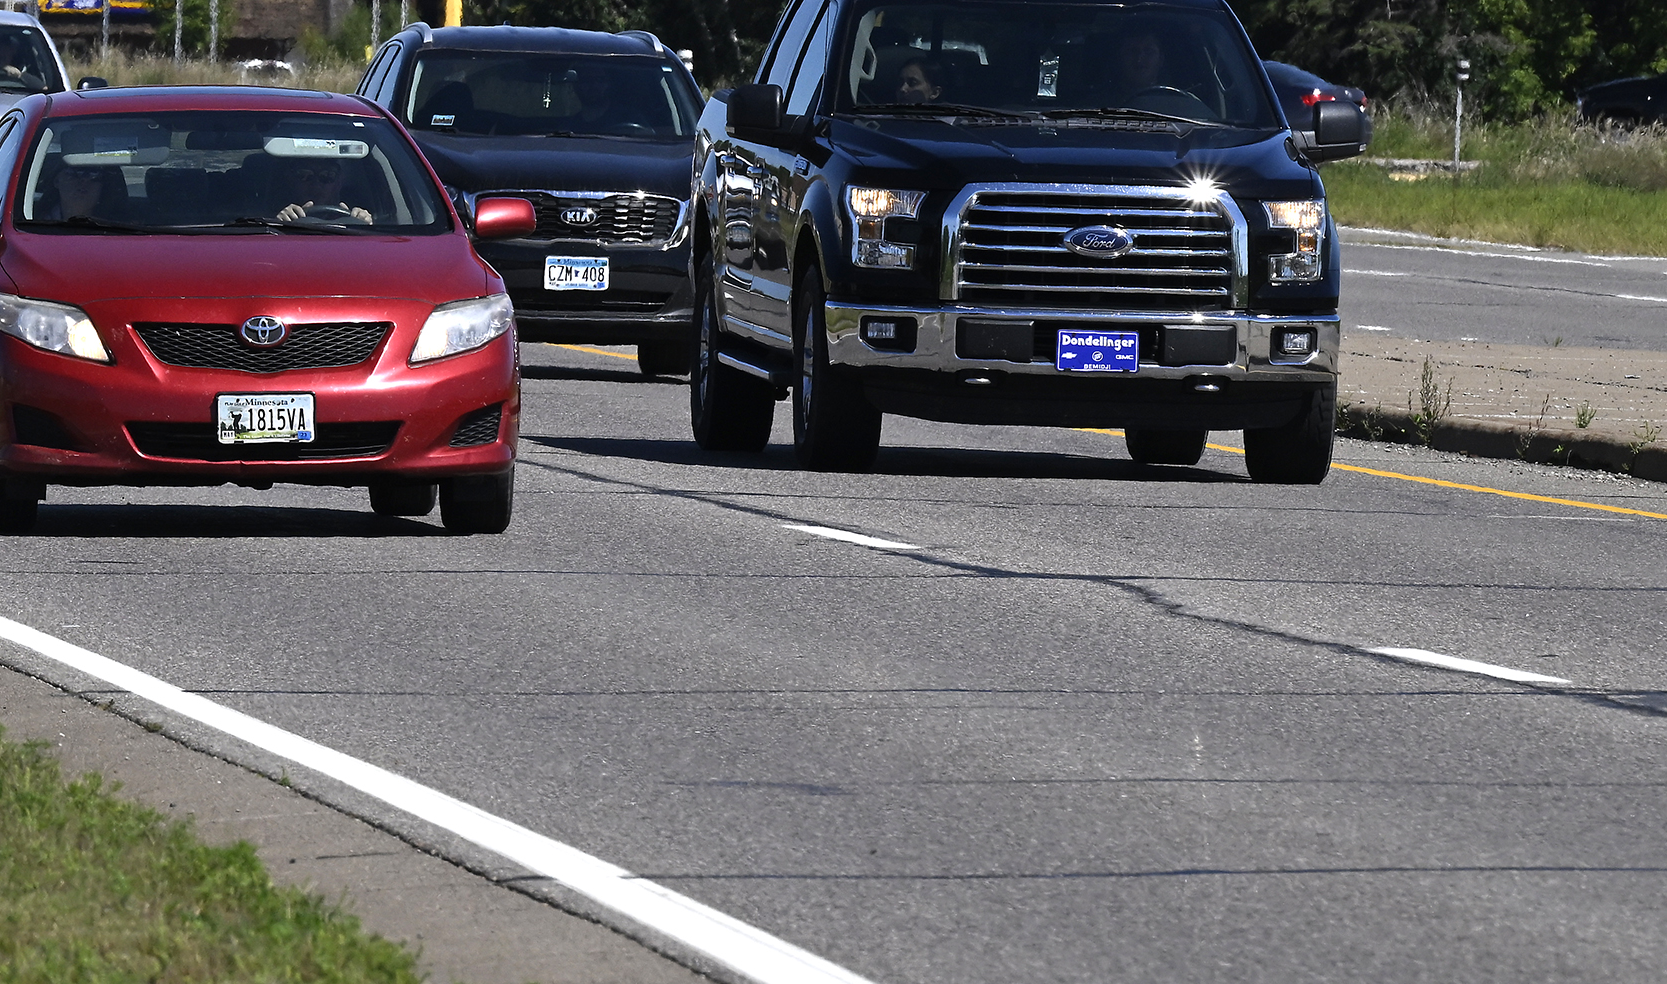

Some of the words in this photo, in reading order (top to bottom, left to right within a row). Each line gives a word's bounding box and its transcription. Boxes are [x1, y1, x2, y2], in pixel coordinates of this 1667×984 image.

[566, 211, 591, 222] KIA
[1082, 232, 1117, 249] Ford
[548, 265, 573, 282] CZM
[582, 266, 605, 282] 408
[1061, 334, 1135, 351] Dondelinger
[245, 398, 289, 406] Minnesota
[247, 408, 306, 431] 1815VA
